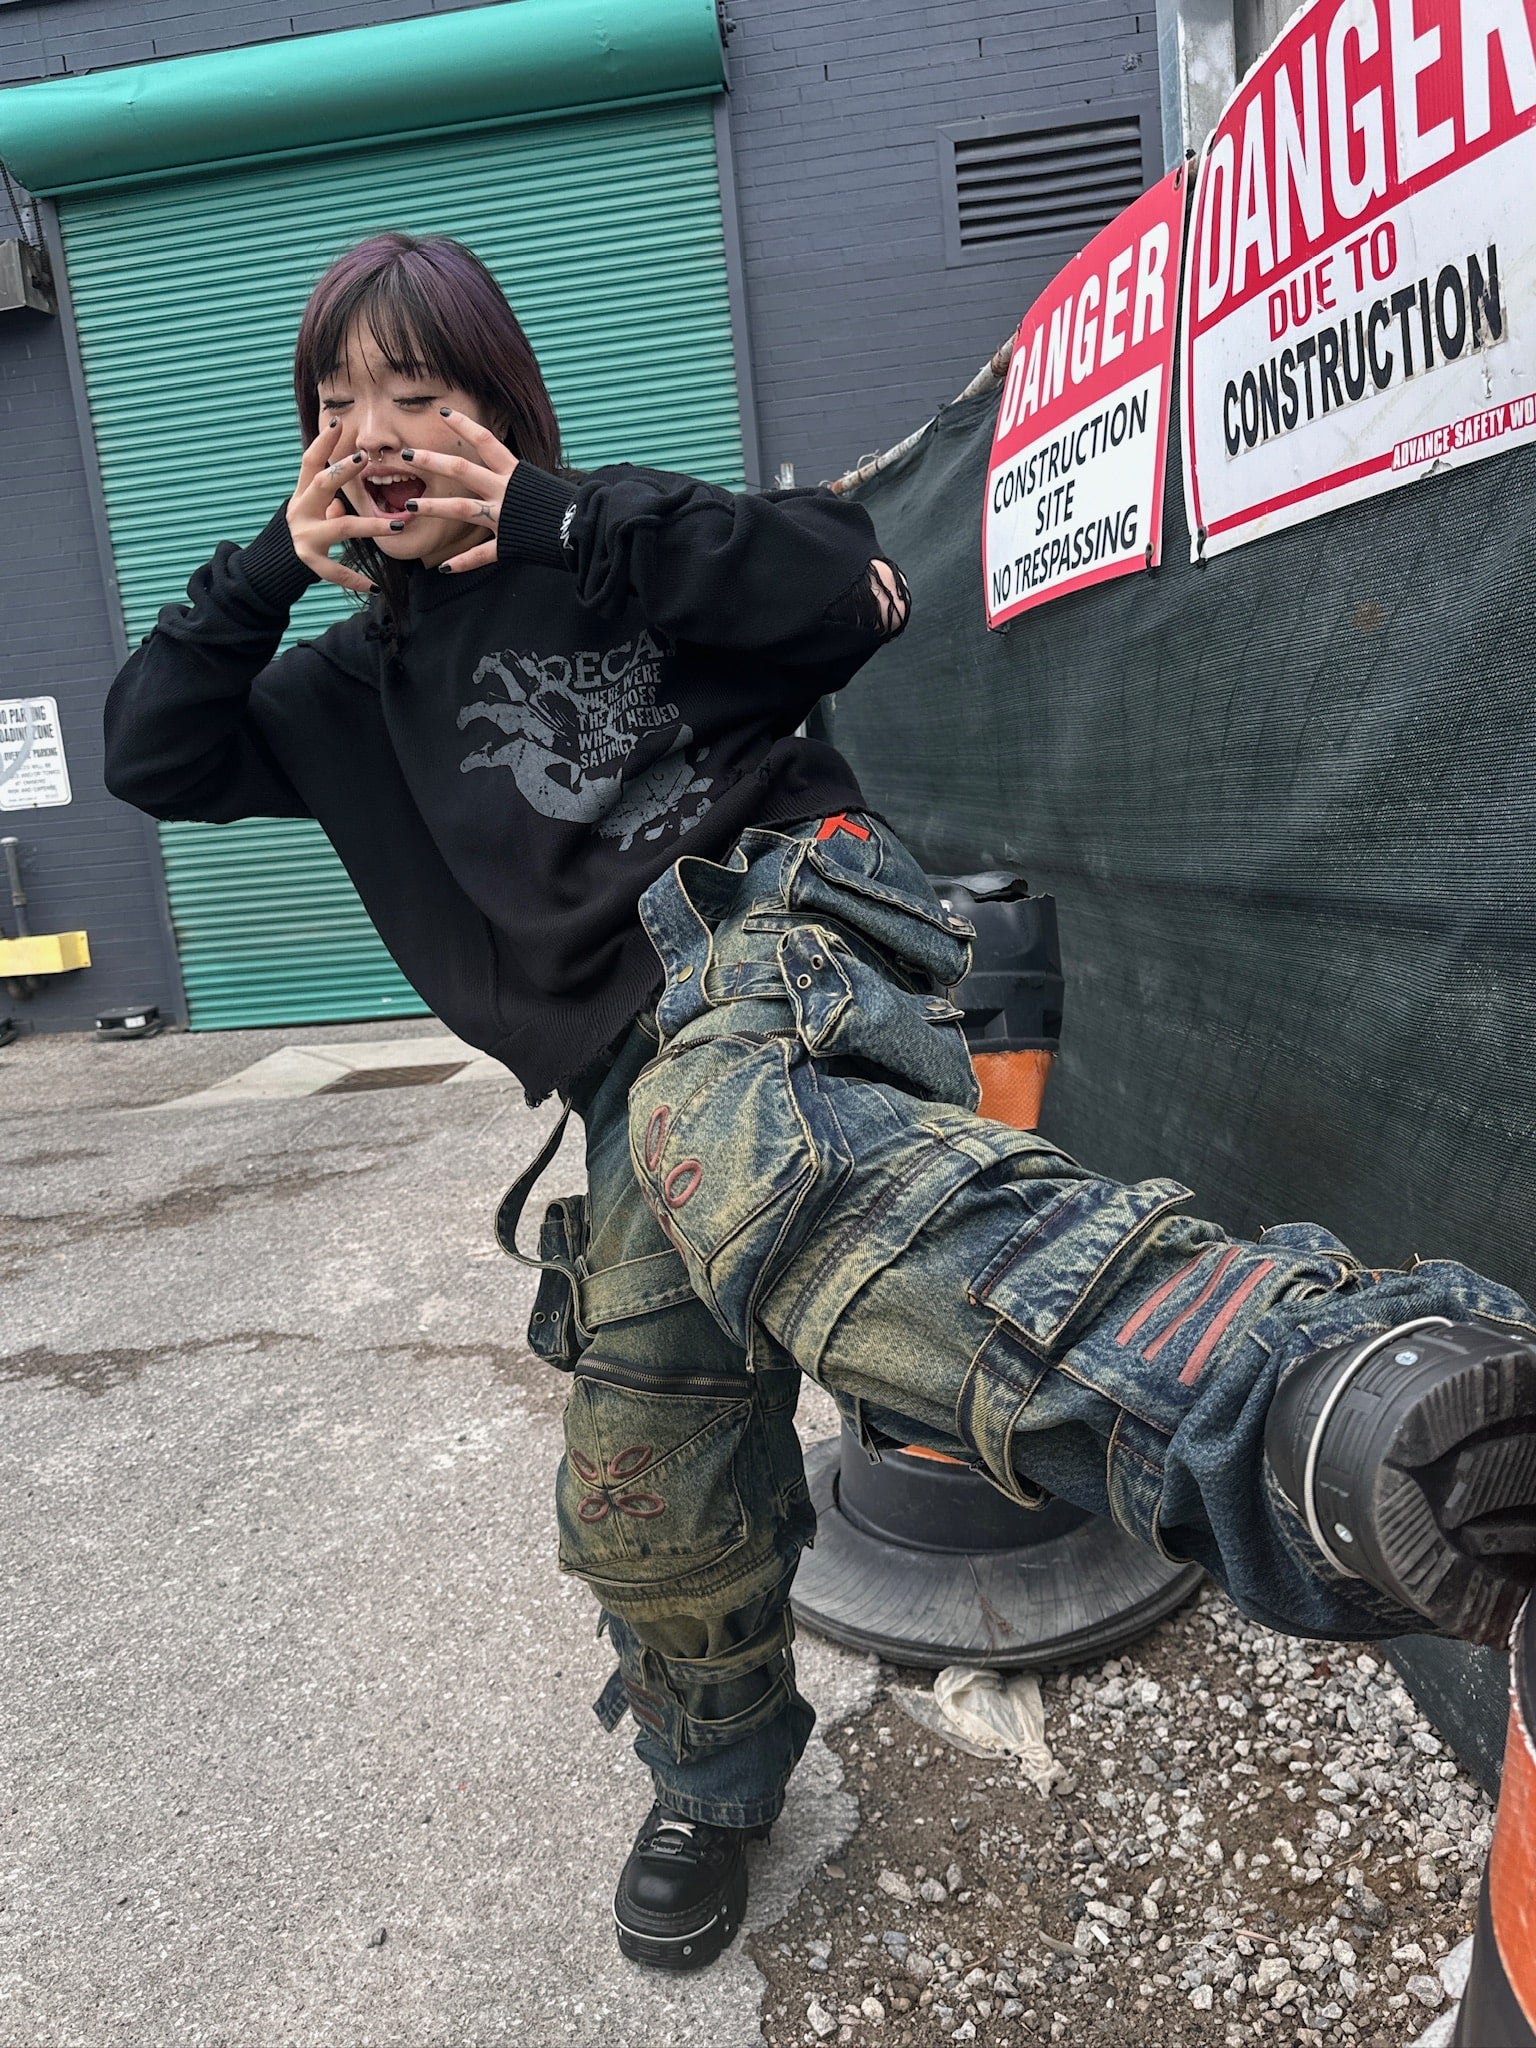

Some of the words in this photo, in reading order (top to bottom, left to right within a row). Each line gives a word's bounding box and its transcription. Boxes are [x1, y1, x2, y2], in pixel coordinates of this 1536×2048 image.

[1269, 256, 1336, 342] DUE
[1345, 221, 1397, 293] TO
[997, 222, 1168, 442] DANGER
[1223, 244, 1501, 456] CONSTRUCTION
[994, 389, 1148, 514] CONSTRUCTION
[1392, 426, 1450, 471] ADVANCE
[1454, 404, 1505, 449] SAFETY
[1508, 395, 1536, 431] WO
[1035, 479, 1075, 536] SITE
[993, 564, 1011, 607] NO
[1015, 504, 1138, 595] TRESPASSING
[609, 686, 657, 720] HEROES
[623, 662, 661, 692] WERE
[626, 703, 680, 728] NEEDED
